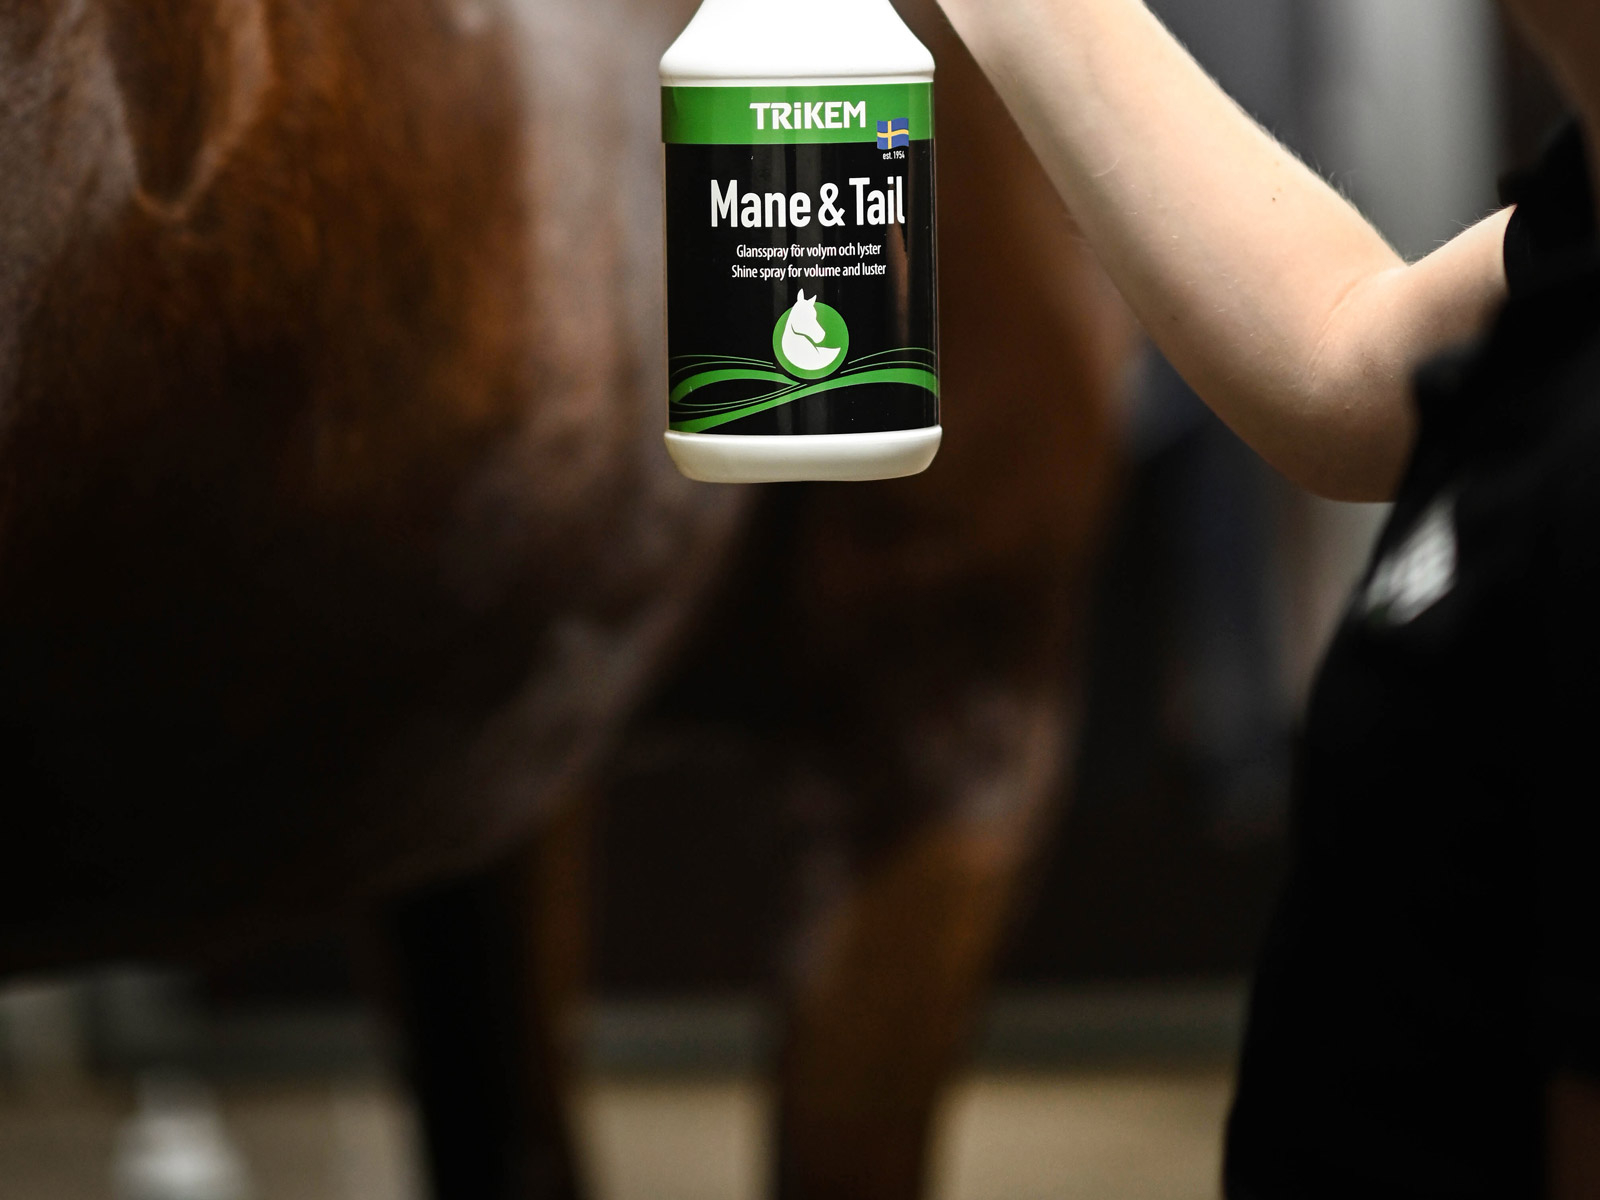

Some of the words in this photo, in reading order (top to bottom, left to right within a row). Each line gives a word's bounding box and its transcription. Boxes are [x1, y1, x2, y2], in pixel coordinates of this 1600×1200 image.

[749, 101, 866, 130] TRiKEM
[710, 179, 811, 228] Mane
[818, 182, 846, 227] &
[849, 175, 906, 226] Tail
[736, 244, 789, 261] Glansspray
[790, 244, 805, 258] för
[807, 243, 837, 260] volym
[839, 243, 856, 256] och
[857, 242, 882, 259] lyster
[731, 264, 758, 278] Shine
[760, 266, 787, 281] spray
[788, 264, 801, 278] for
[804, 263, 840, 277] volume
[842, 263, 861, 276] and
[862, 262, 887, 275] luster
